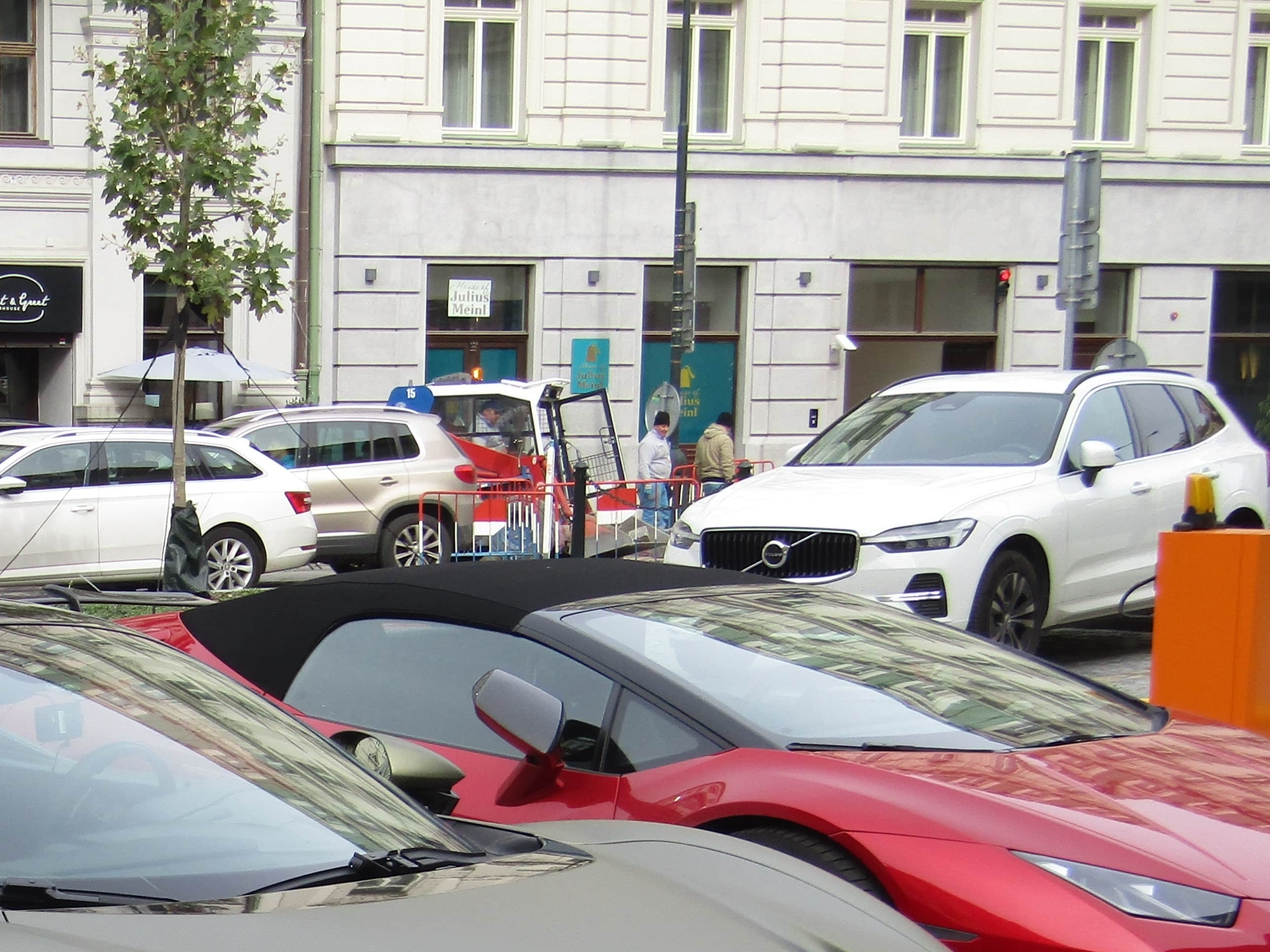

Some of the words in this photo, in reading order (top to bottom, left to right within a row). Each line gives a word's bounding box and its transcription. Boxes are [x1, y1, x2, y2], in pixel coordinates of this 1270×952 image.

[9, 296, 17, 306] &
[19, 292, 51, 312] Greet
[450, 290, 489, 303] Julius
[452, 303, 486, 316] Meinl
[406, 387, 417, 399] 15
